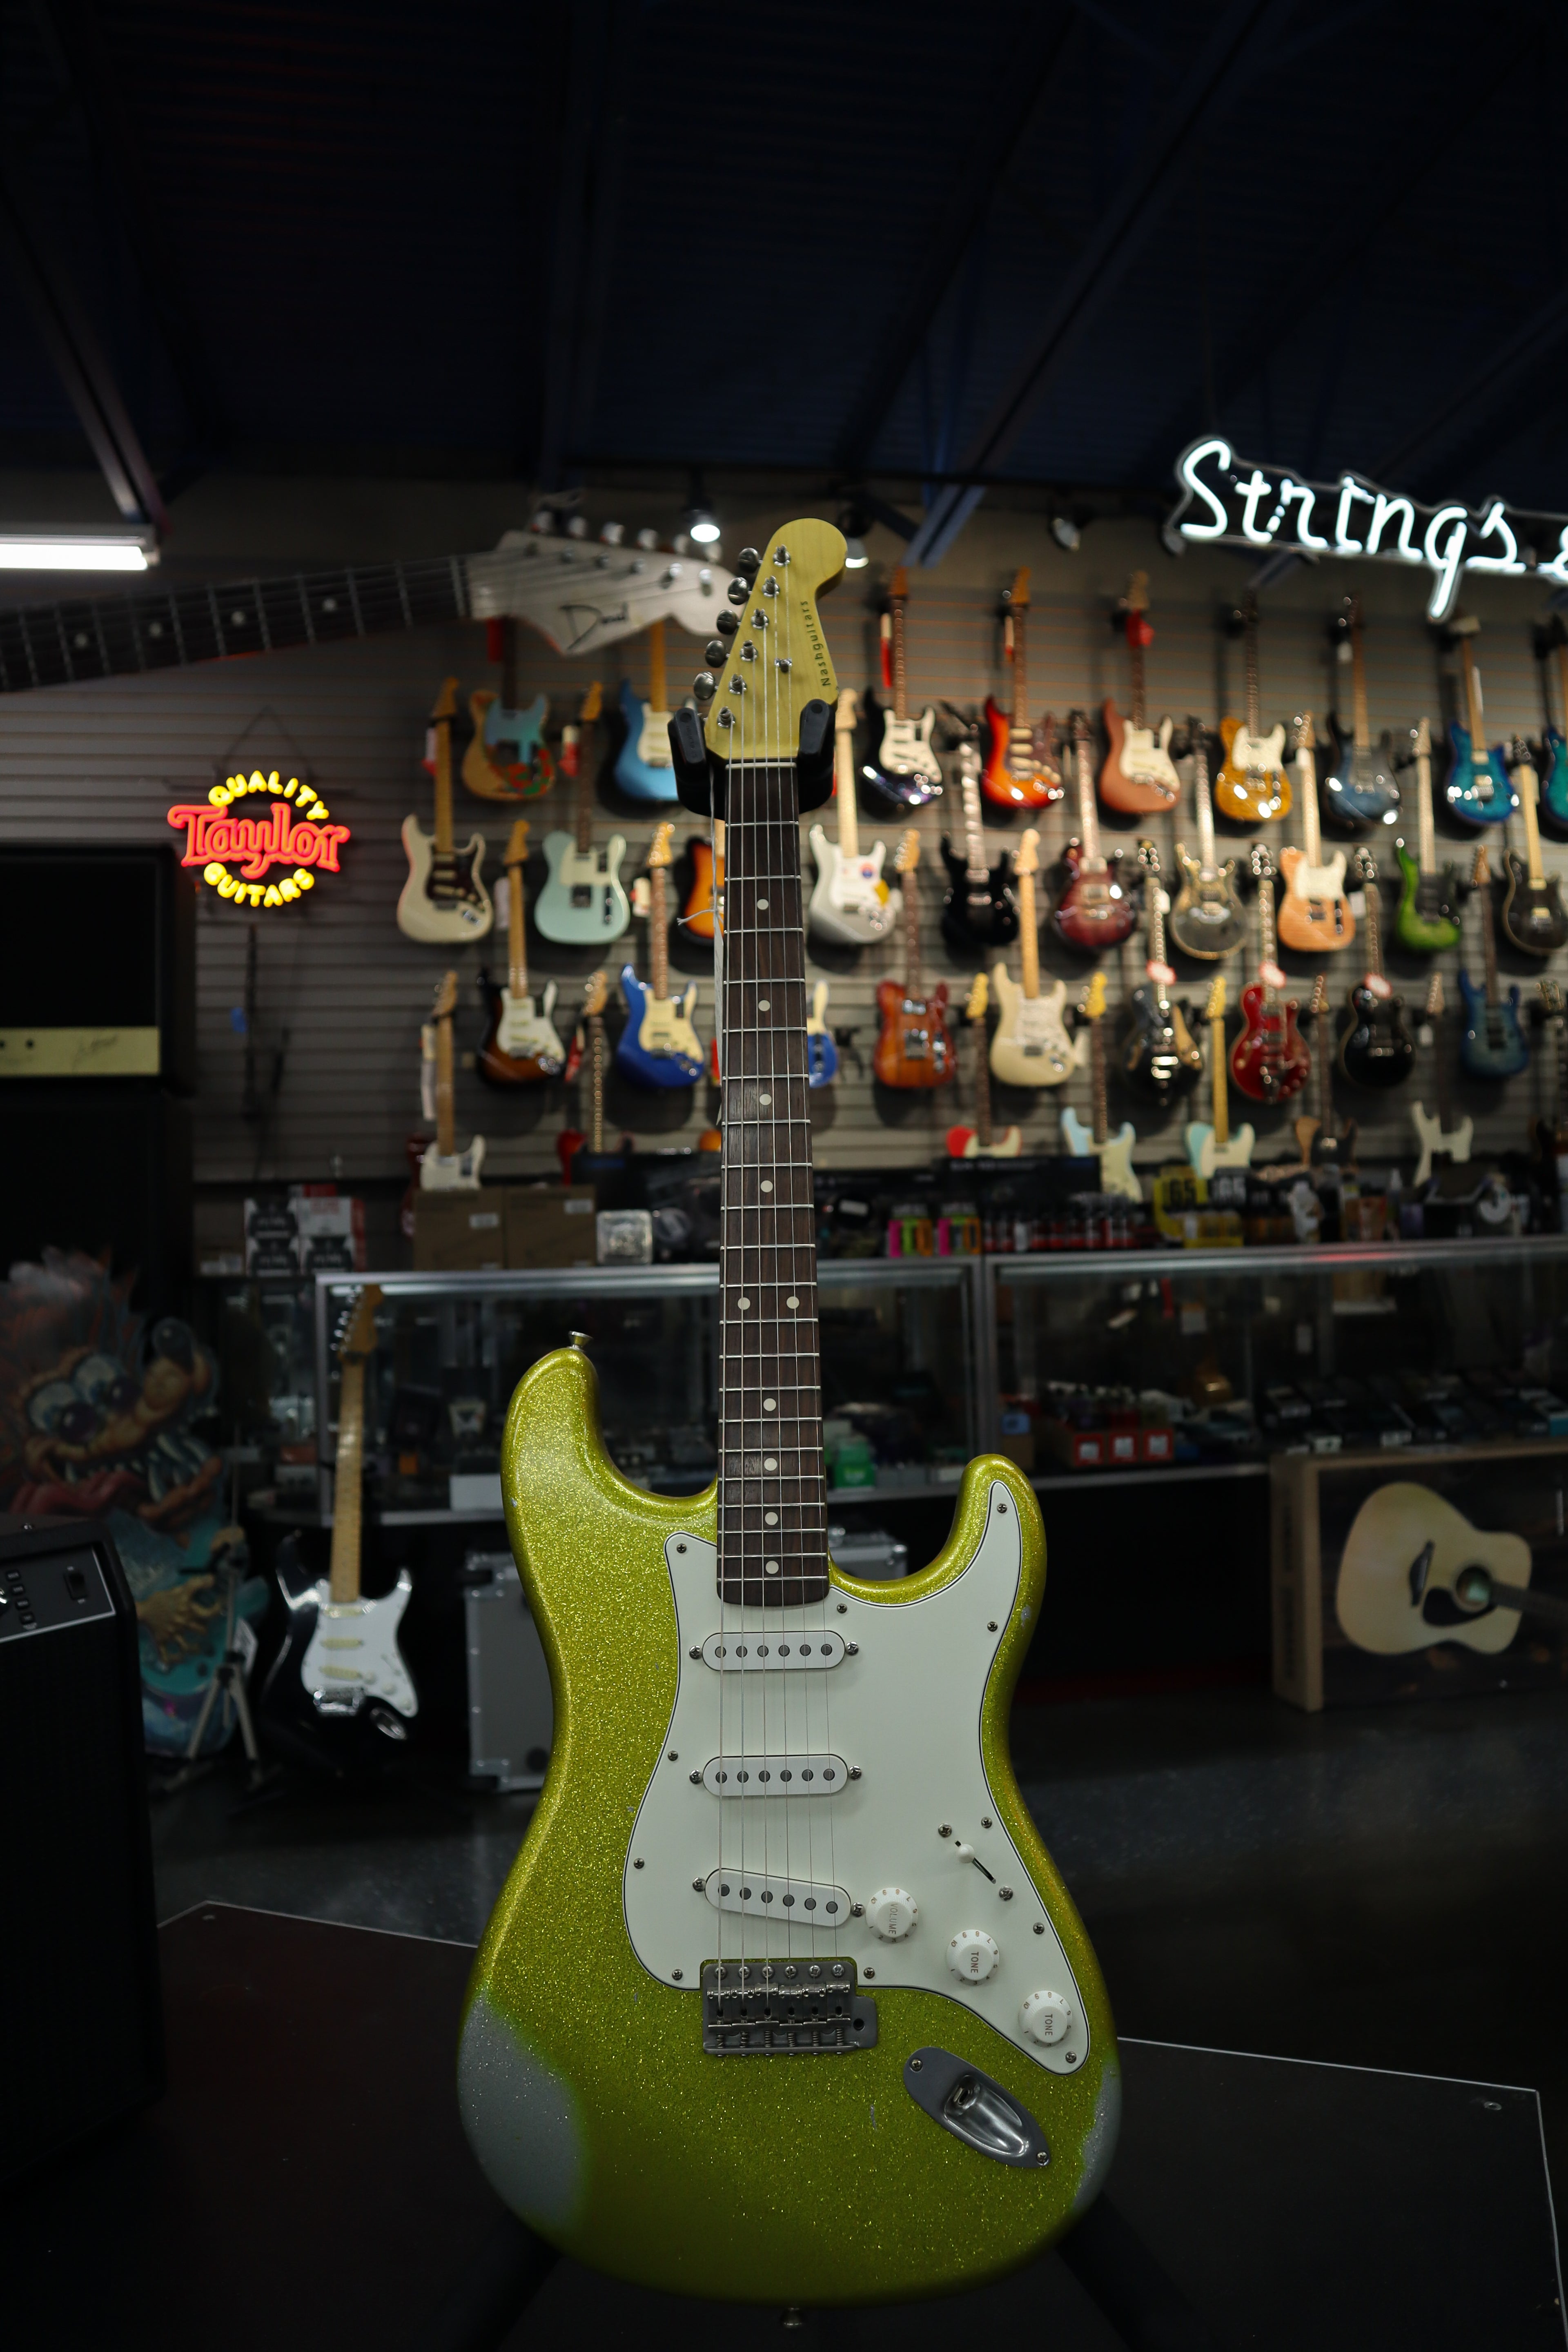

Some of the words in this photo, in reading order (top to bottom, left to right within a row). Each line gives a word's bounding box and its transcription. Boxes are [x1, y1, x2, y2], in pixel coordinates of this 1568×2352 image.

[1180, 439, 1527, 619] Strings
[208, 770, 330, 821] QUALITY
[167, 802, 351, 880] Taylor
[204, 862, 315, 908] GUITARS
[889, 1904, 898, 1934] VOLUME
[971, 1952, 979, 1973] TONE
[1045, 2014, 1053, 2036] TONE
